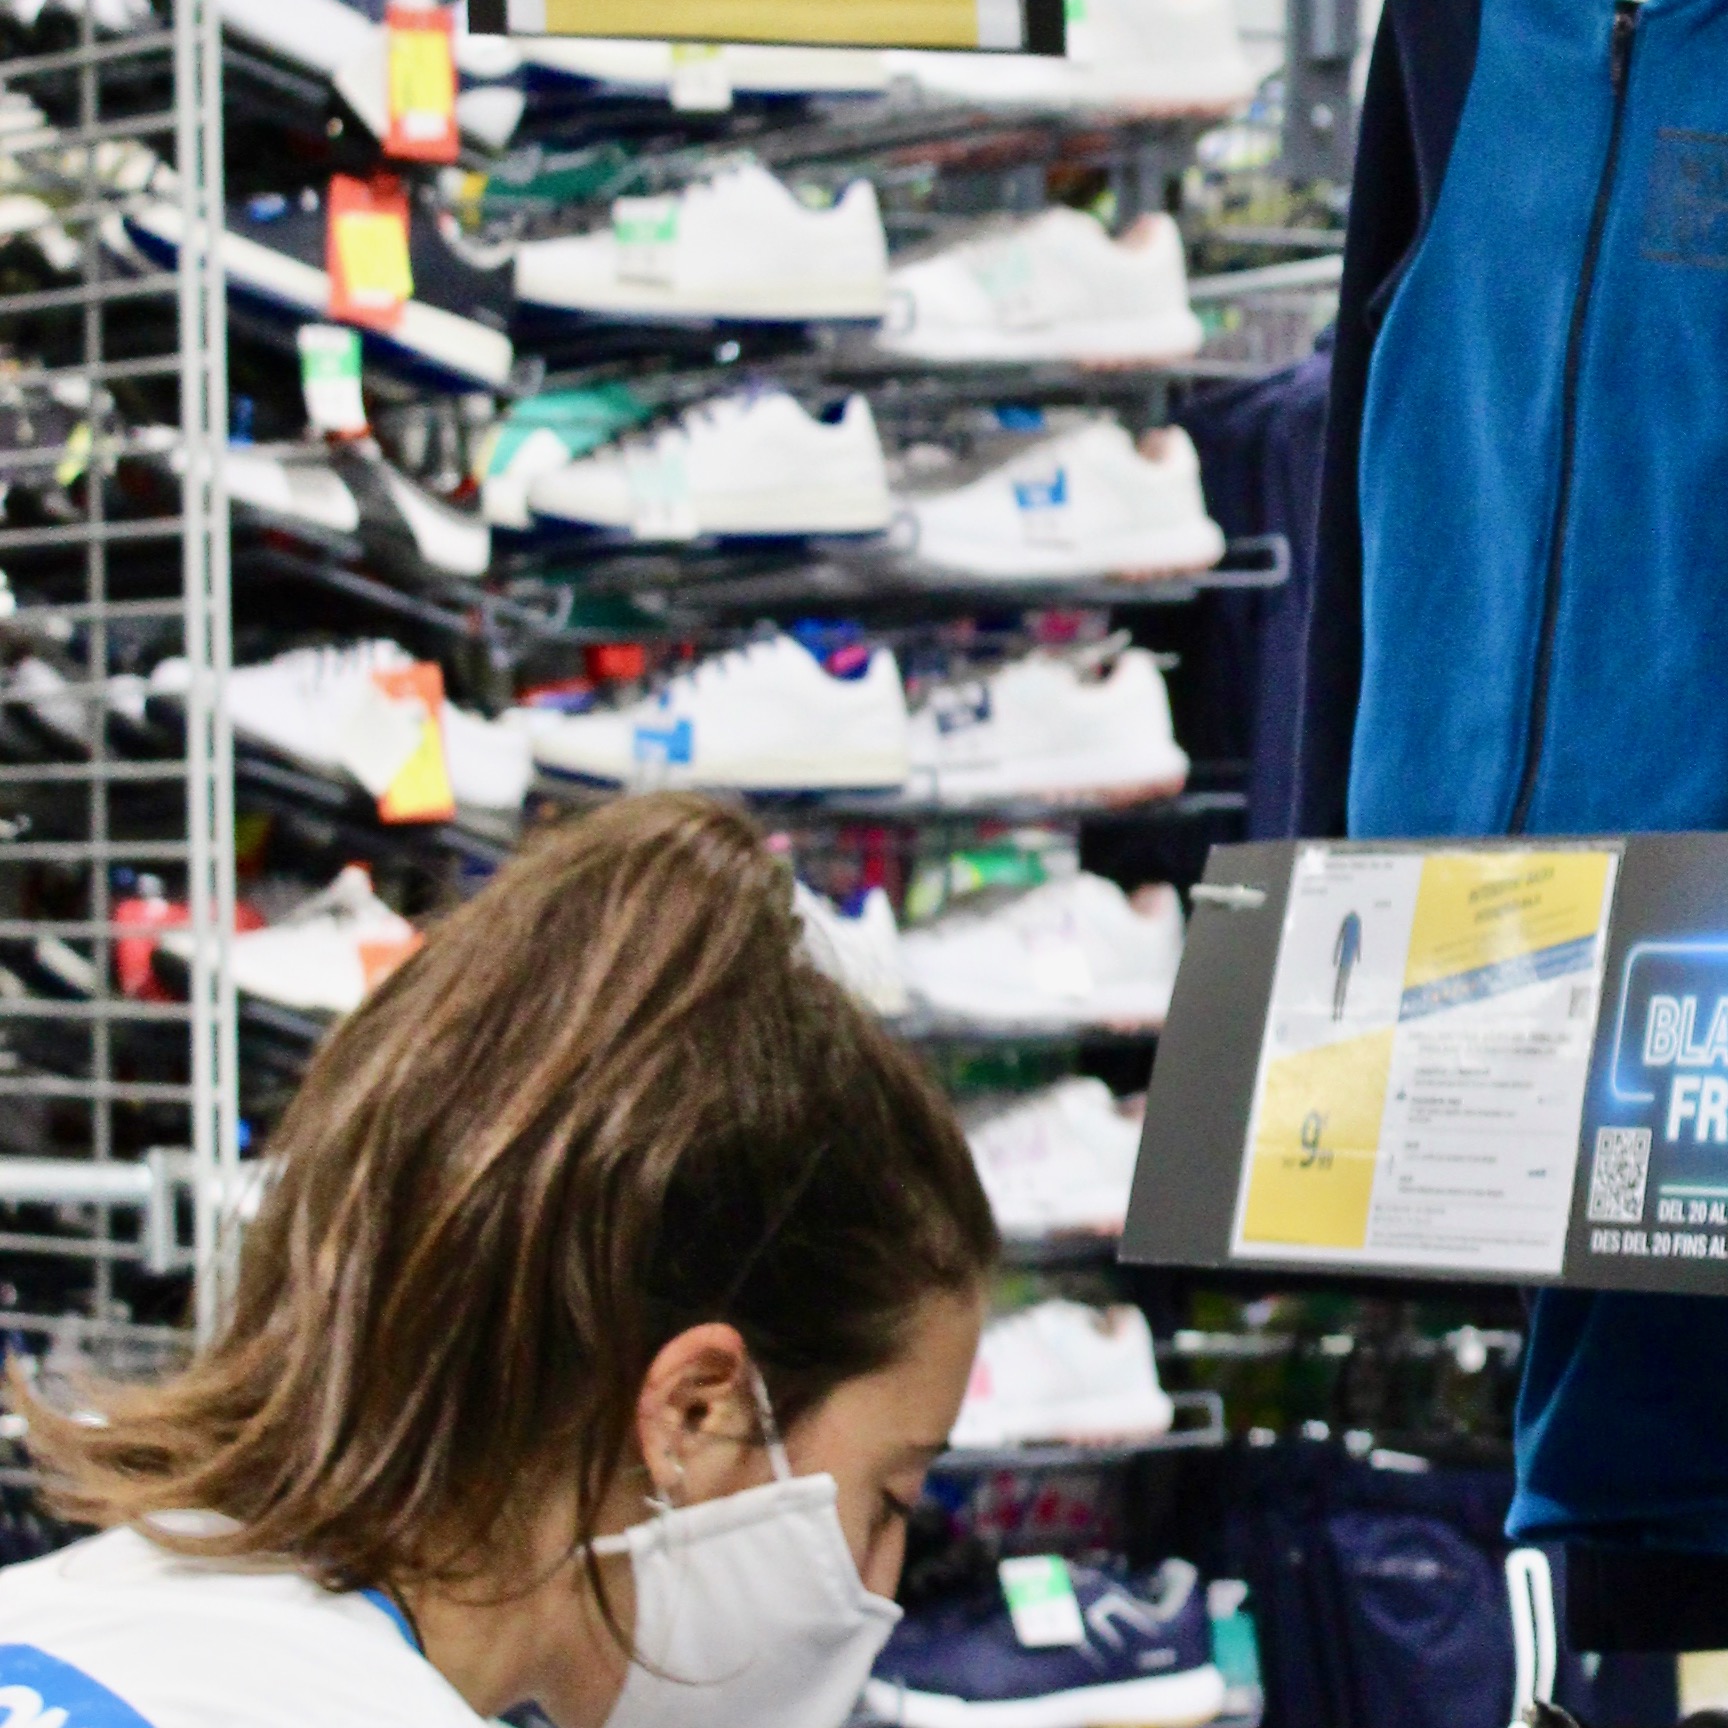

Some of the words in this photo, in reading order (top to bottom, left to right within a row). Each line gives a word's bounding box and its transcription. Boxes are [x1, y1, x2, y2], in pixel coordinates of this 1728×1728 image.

[1657, 1197, 1686, 1223] DEL
[1688, 1199, 1707, 1224] 20
[1708, 1200, 1728, 1226] AL
[1590, 1228, 1621, 1255] DES
[1622, 1230, 1651, 1256] DEL
[1651, 1231, 1672, 1257] 20
[1672, 1232, 1707, 1259] FINS
[1708, 1233, 1728, 1260] AL
